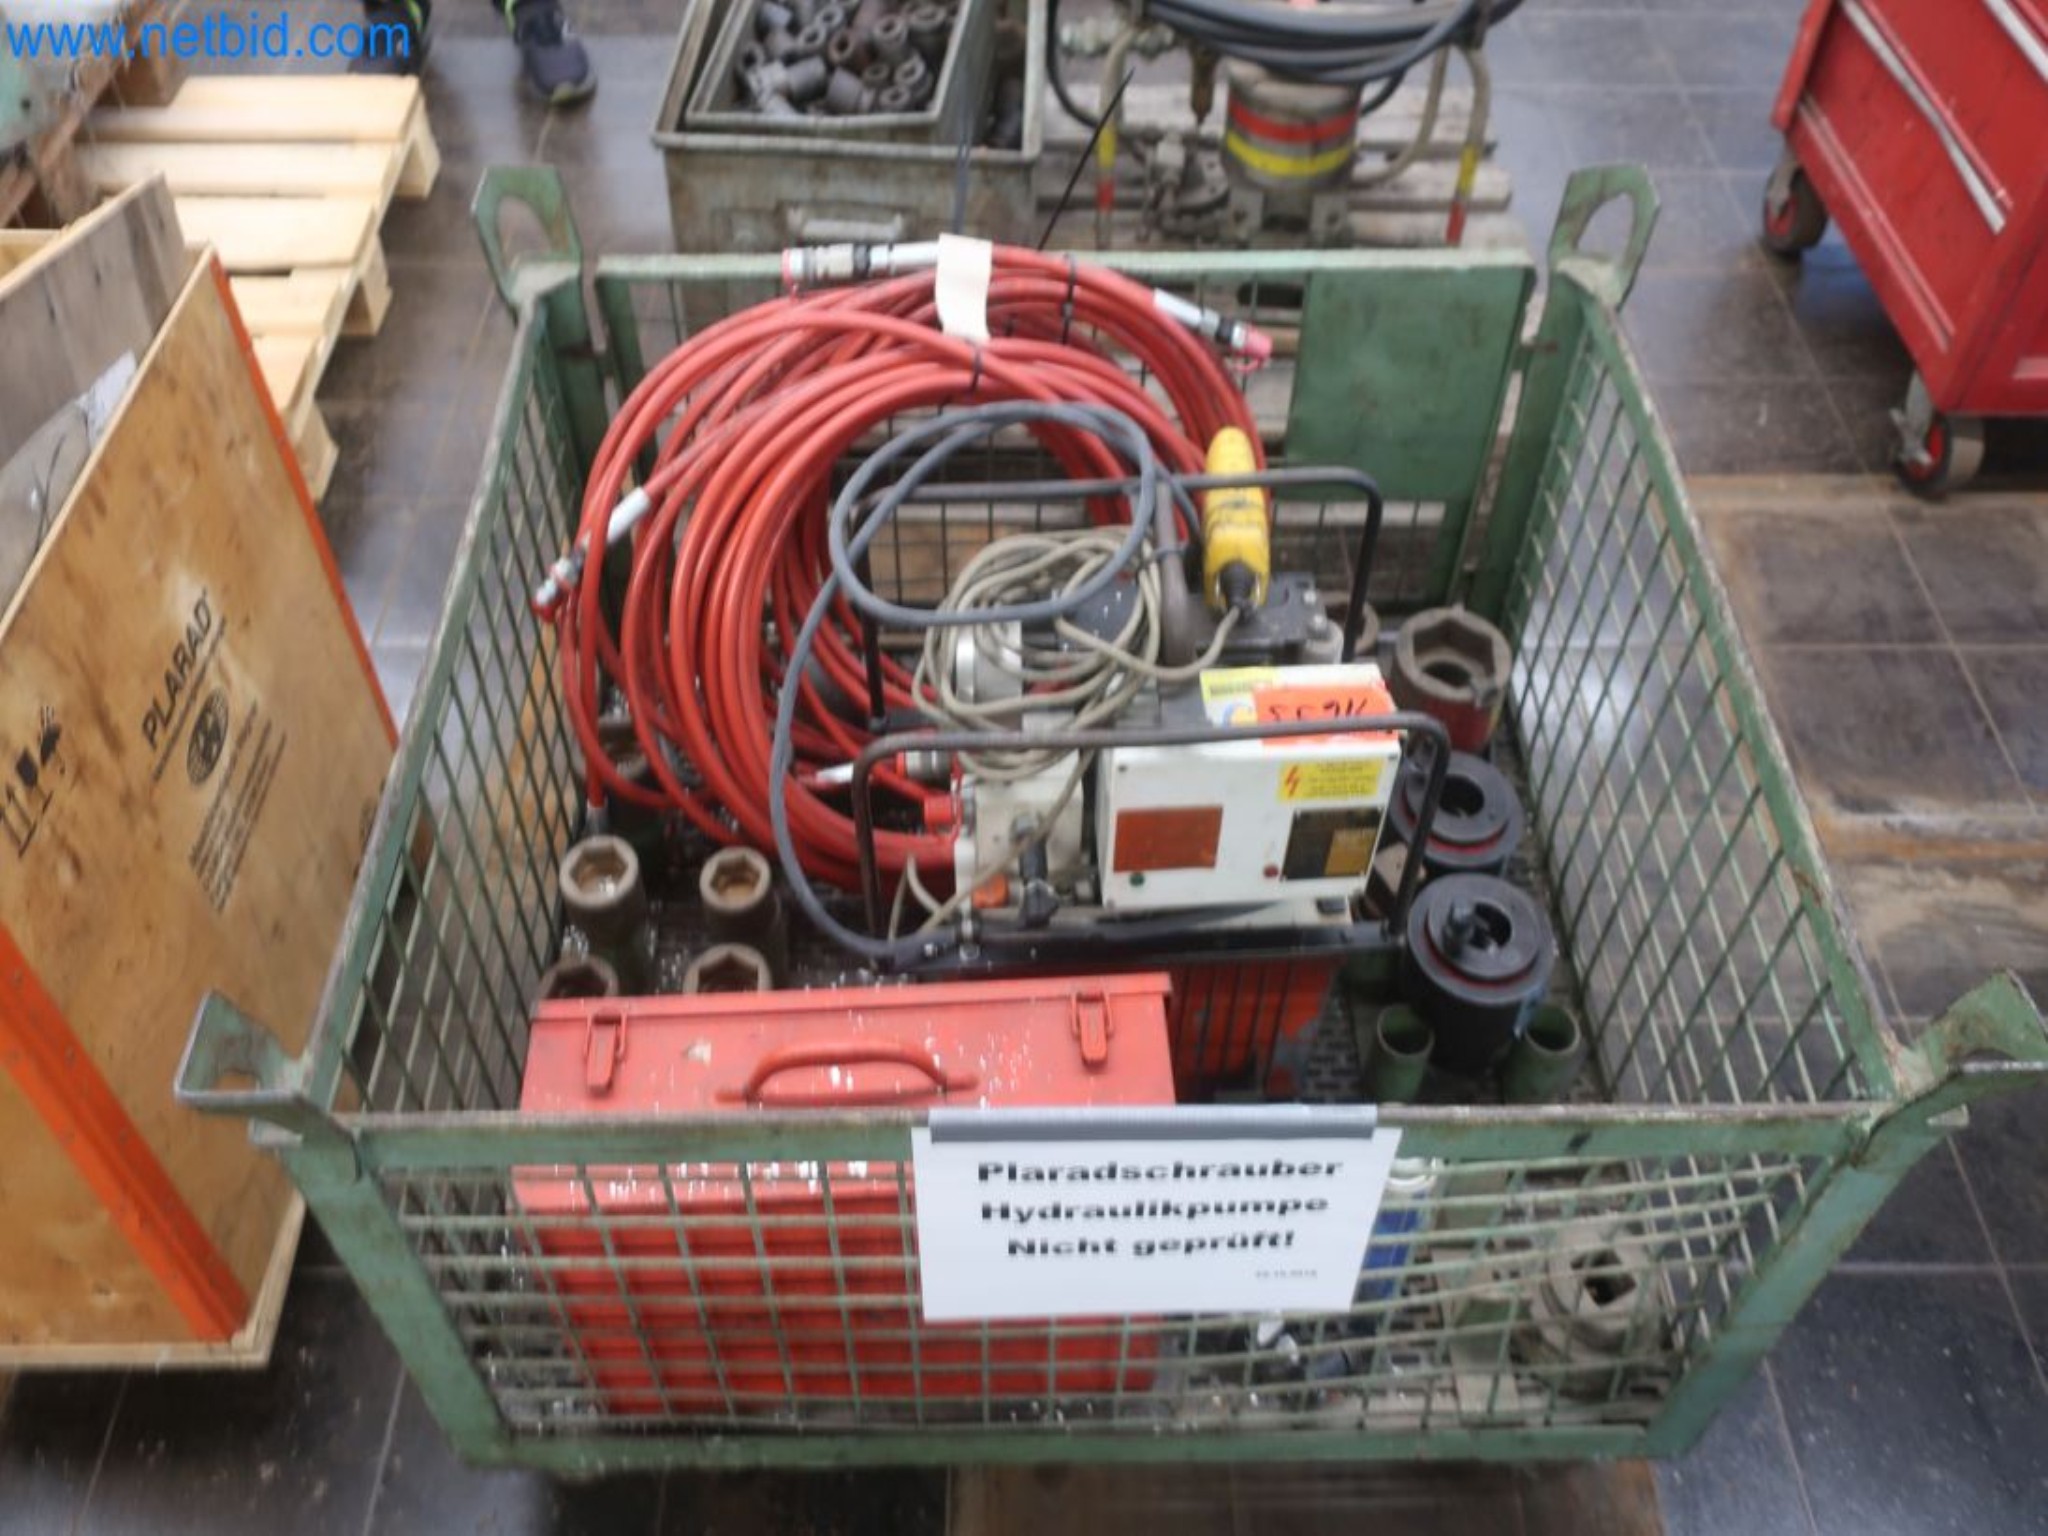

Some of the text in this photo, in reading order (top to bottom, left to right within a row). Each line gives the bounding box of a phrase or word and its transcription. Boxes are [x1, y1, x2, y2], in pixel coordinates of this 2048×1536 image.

[977, 1158, 1343, 1183] Plaradschrauber
[980, 1195, 1330, 1224] Hydraulikpumpe
[1006, 1230, 1297, 1258] Nicht geprüft!
